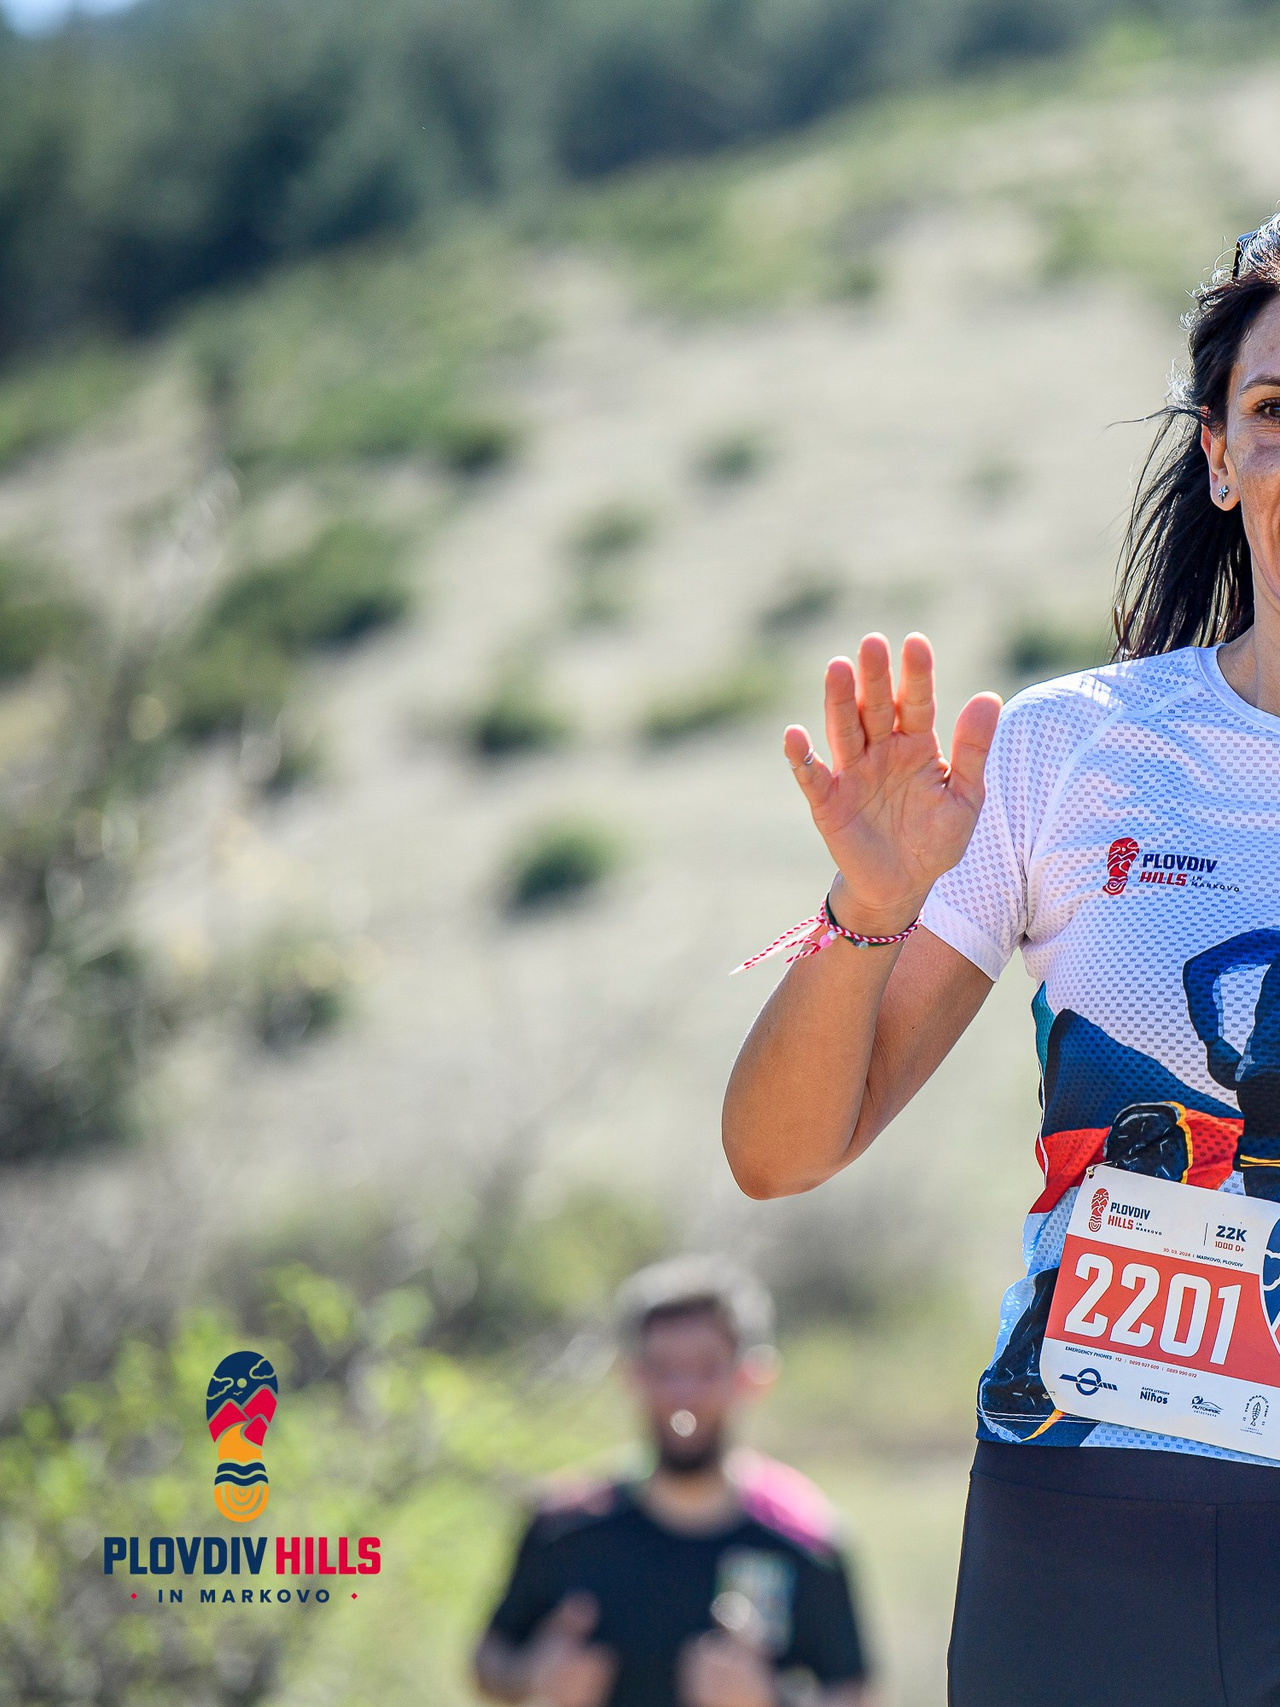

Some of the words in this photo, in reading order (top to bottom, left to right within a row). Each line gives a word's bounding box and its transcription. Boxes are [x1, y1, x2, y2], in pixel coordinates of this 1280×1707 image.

[1142, 853, 1218, 873] PLOVDIV
[1139, 871, 1188, 886] HILLS
[1191, 881, 1240, 892] MARKOVO
[1110, 1202, 1151, 1220] PLOVDIV
[1107, 1214, 1134, 1230] HILLS
[1215, 1225, 1247, 1242] 22K
[1215, 1241, 1234, 1251] 1000
[1222, 1259, 1244, 1267] PLOVDIV
[1063, 1253, 1242, 1366] 2201
[1065, 1346, 1093, 1356] EMERGENCY
[1093, 1352, 1112, 1360] PHONES
